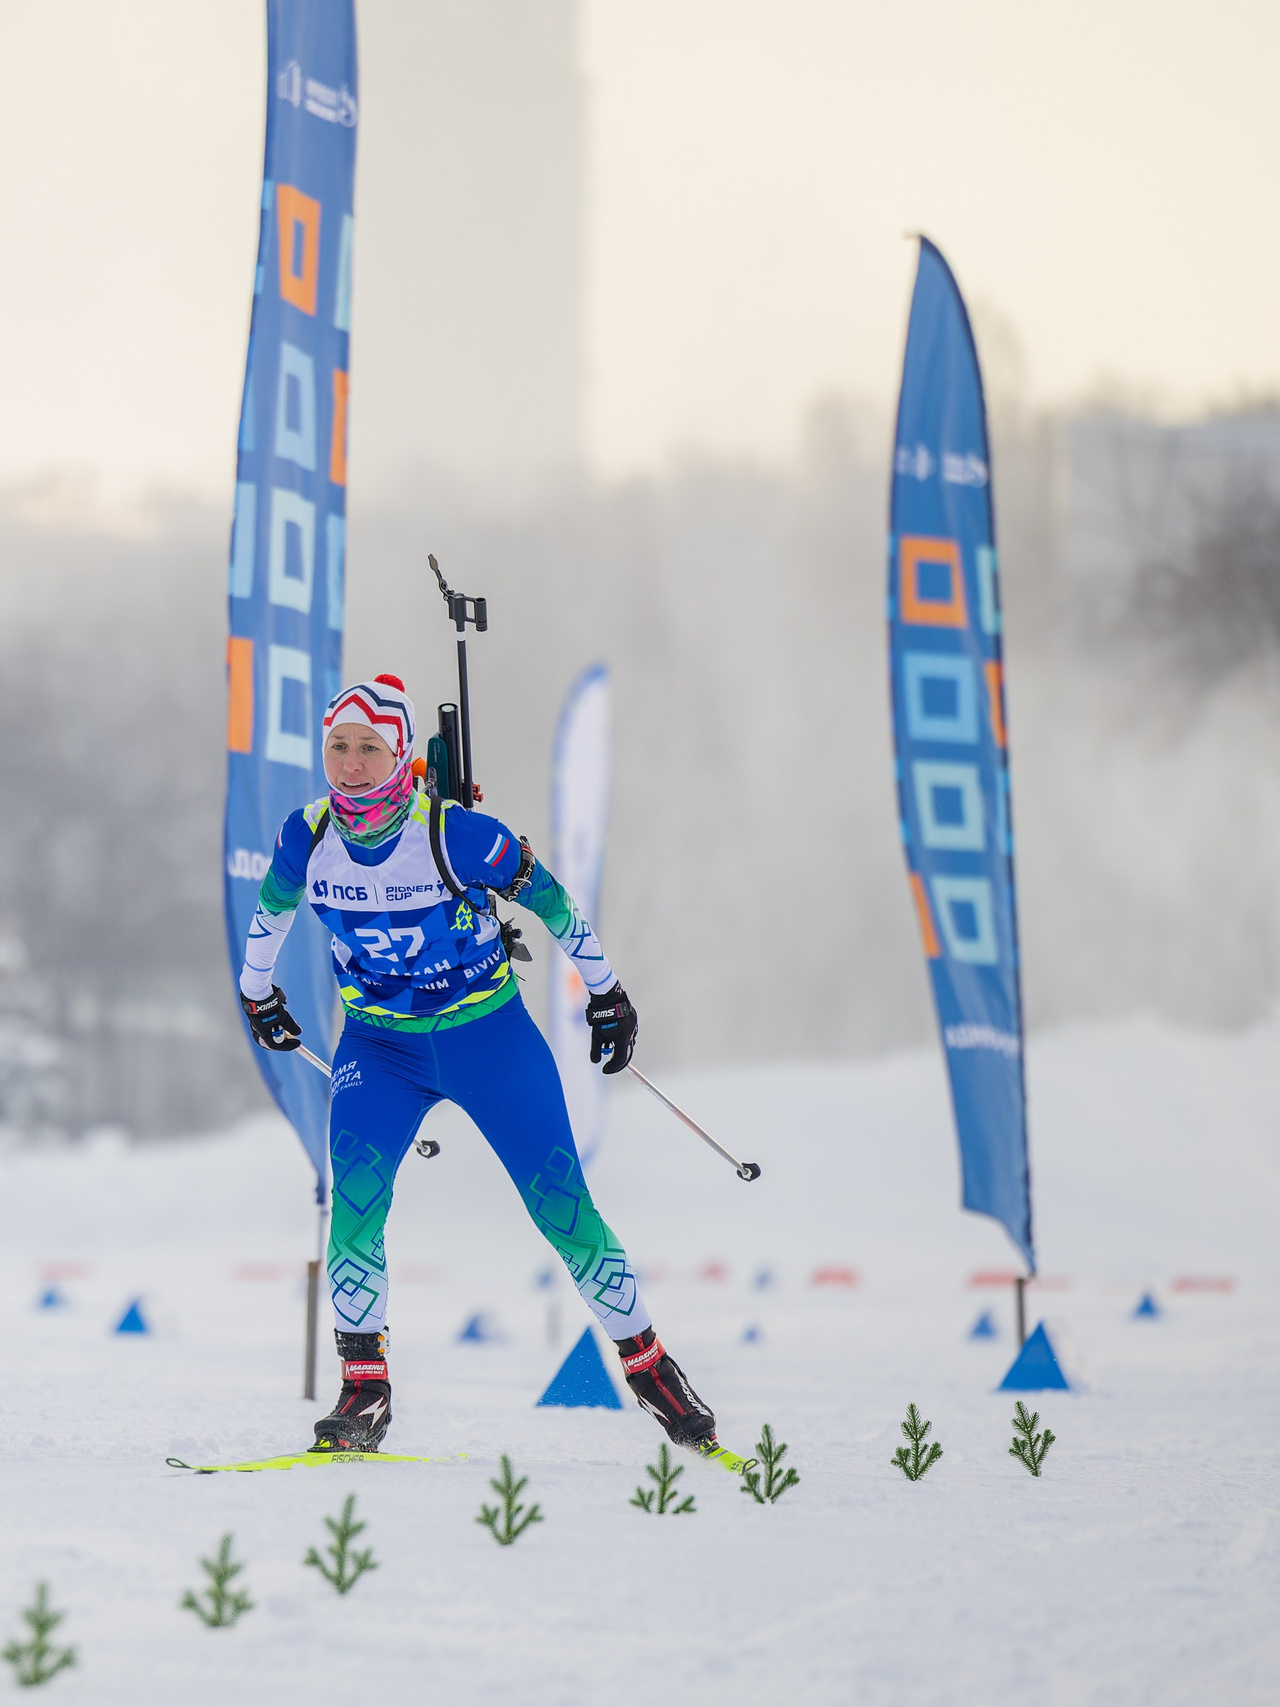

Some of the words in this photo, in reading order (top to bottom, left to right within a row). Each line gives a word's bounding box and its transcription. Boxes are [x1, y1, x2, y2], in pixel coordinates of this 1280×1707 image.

[333, 885, 368, 901] ПСБ
[386, 884, 433, 893] PIONER
[386, 893, 412, 901] CUP
[354, 926, 425, 962] 27
[592, 1008, 616, 1019] SWIX
